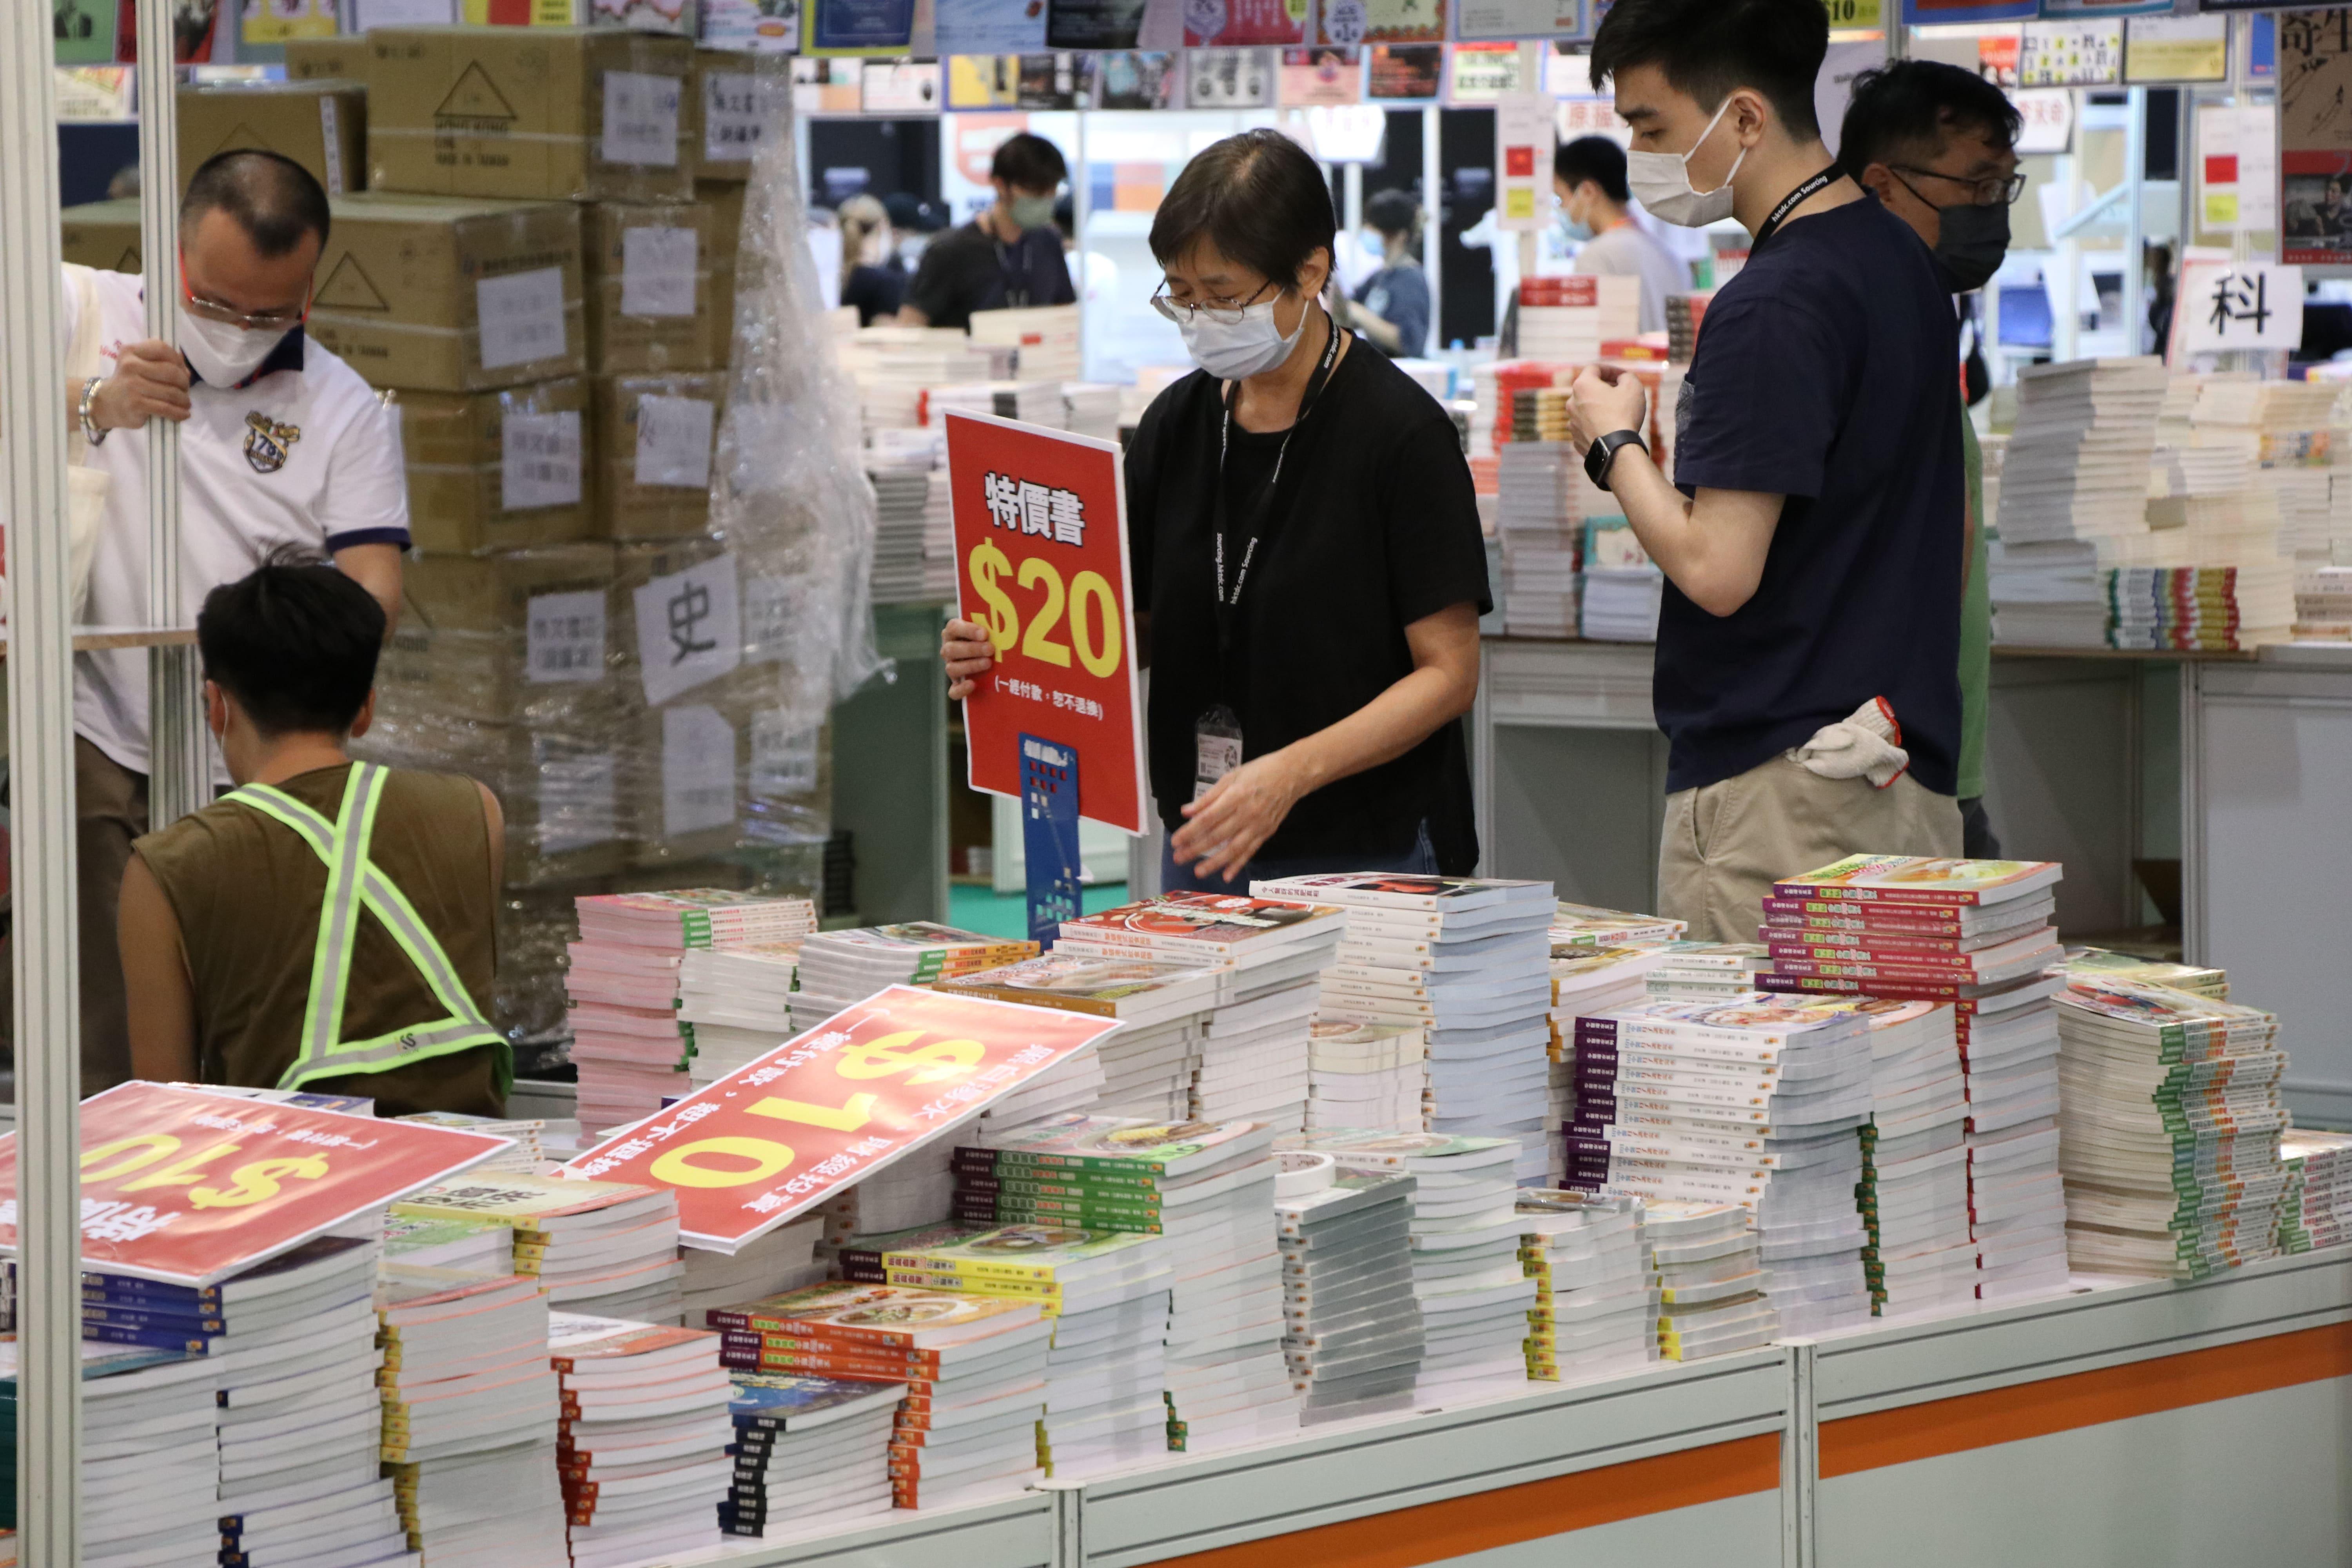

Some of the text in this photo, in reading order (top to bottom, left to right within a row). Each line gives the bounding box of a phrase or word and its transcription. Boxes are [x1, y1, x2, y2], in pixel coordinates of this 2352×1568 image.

[1771, 176, 1828, 223] hktdc.com Sourcing
[2209, 270, 2271, 335] 科
[984, 470, 1085, 546] 特價書
[668, 580, 717, 666] 史
[968, 537, 1122, 678] $20
[649, 1031, 985, 1188] $10
[80, 1134, 330, 1210] $10
